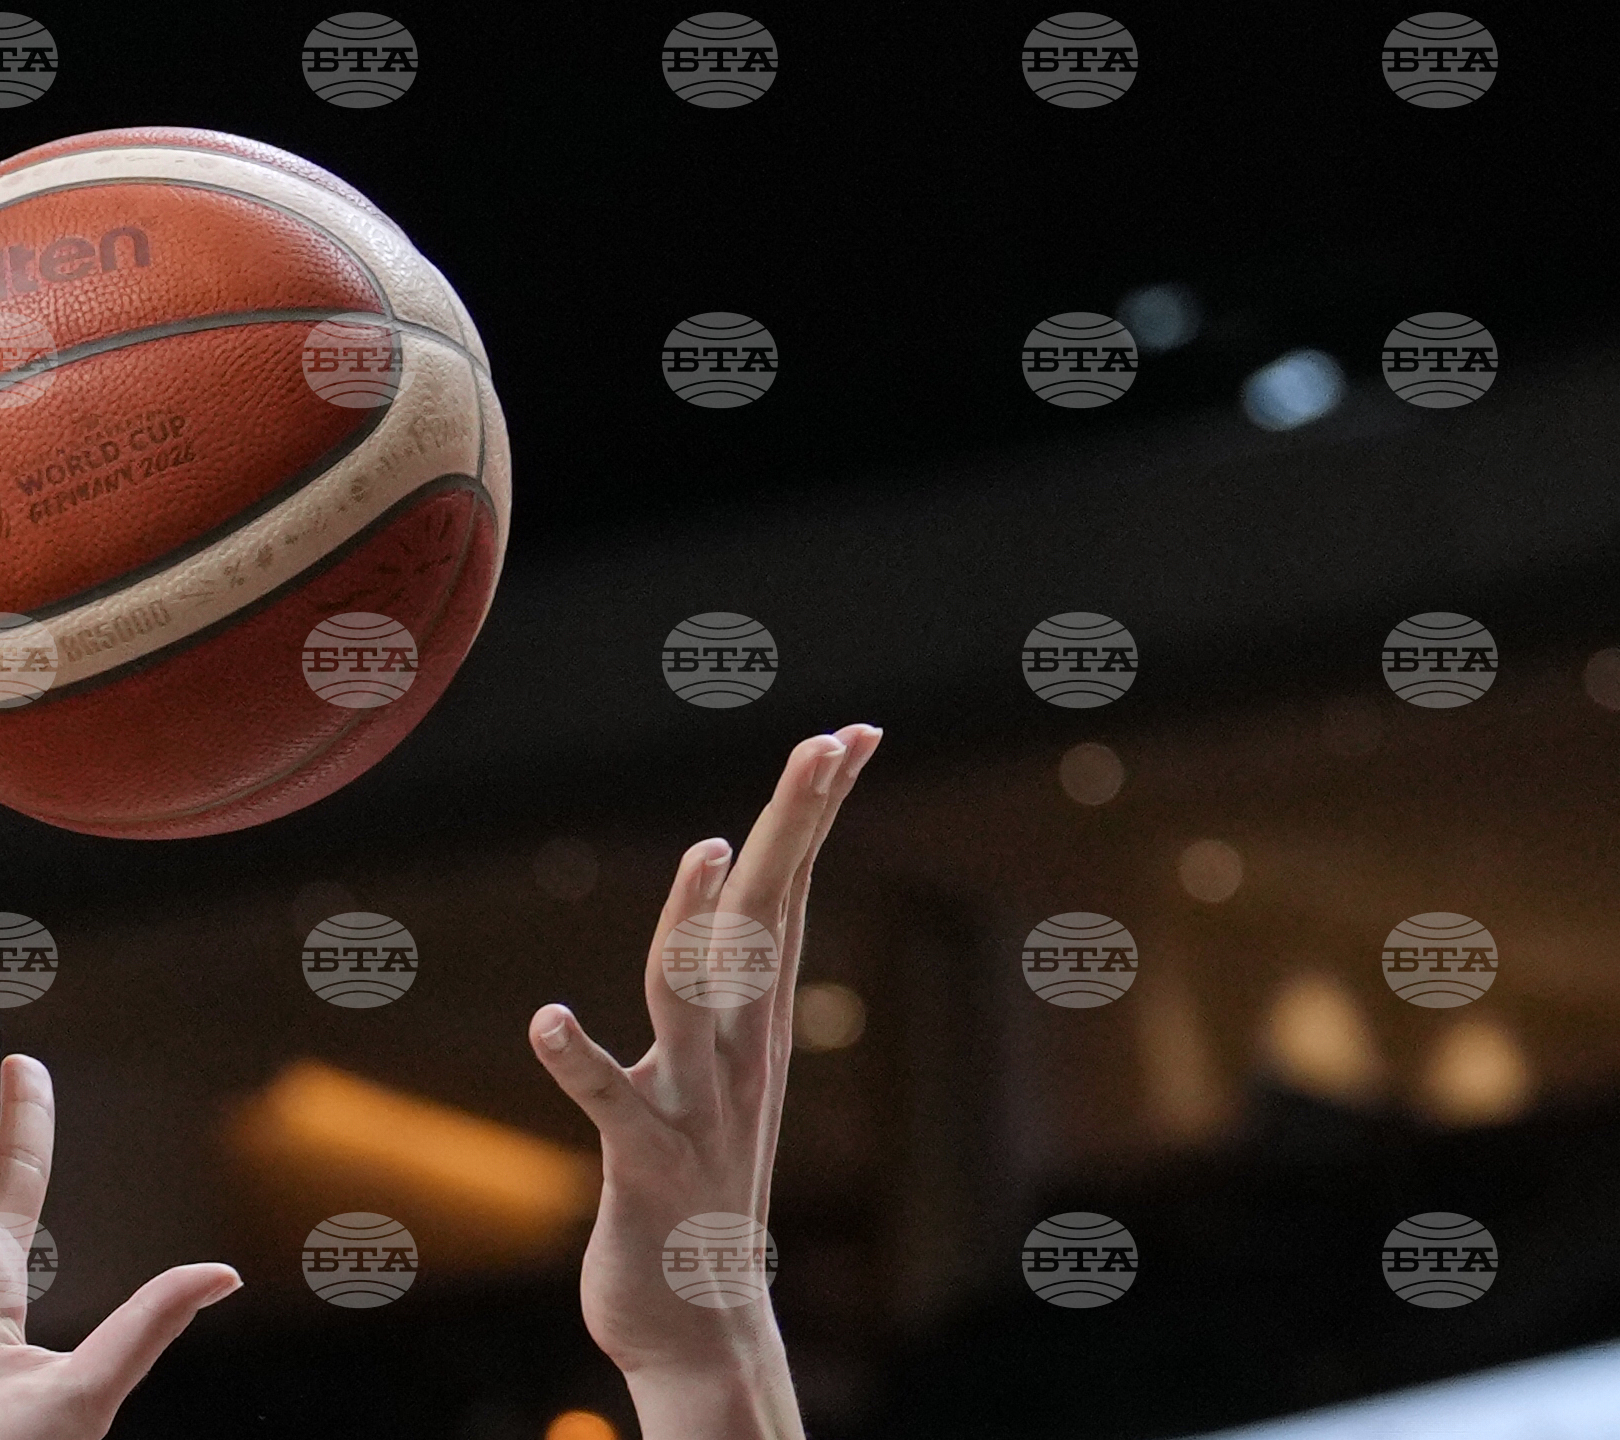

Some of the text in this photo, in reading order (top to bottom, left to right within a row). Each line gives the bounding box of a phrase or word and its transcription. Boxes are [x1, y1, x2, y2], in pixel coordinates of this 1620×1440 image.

[15, 440, 120, 496] WORLD
[128, 415, 187, 451] CUP
[28, 439, 197, 524] GERMANY 2026
